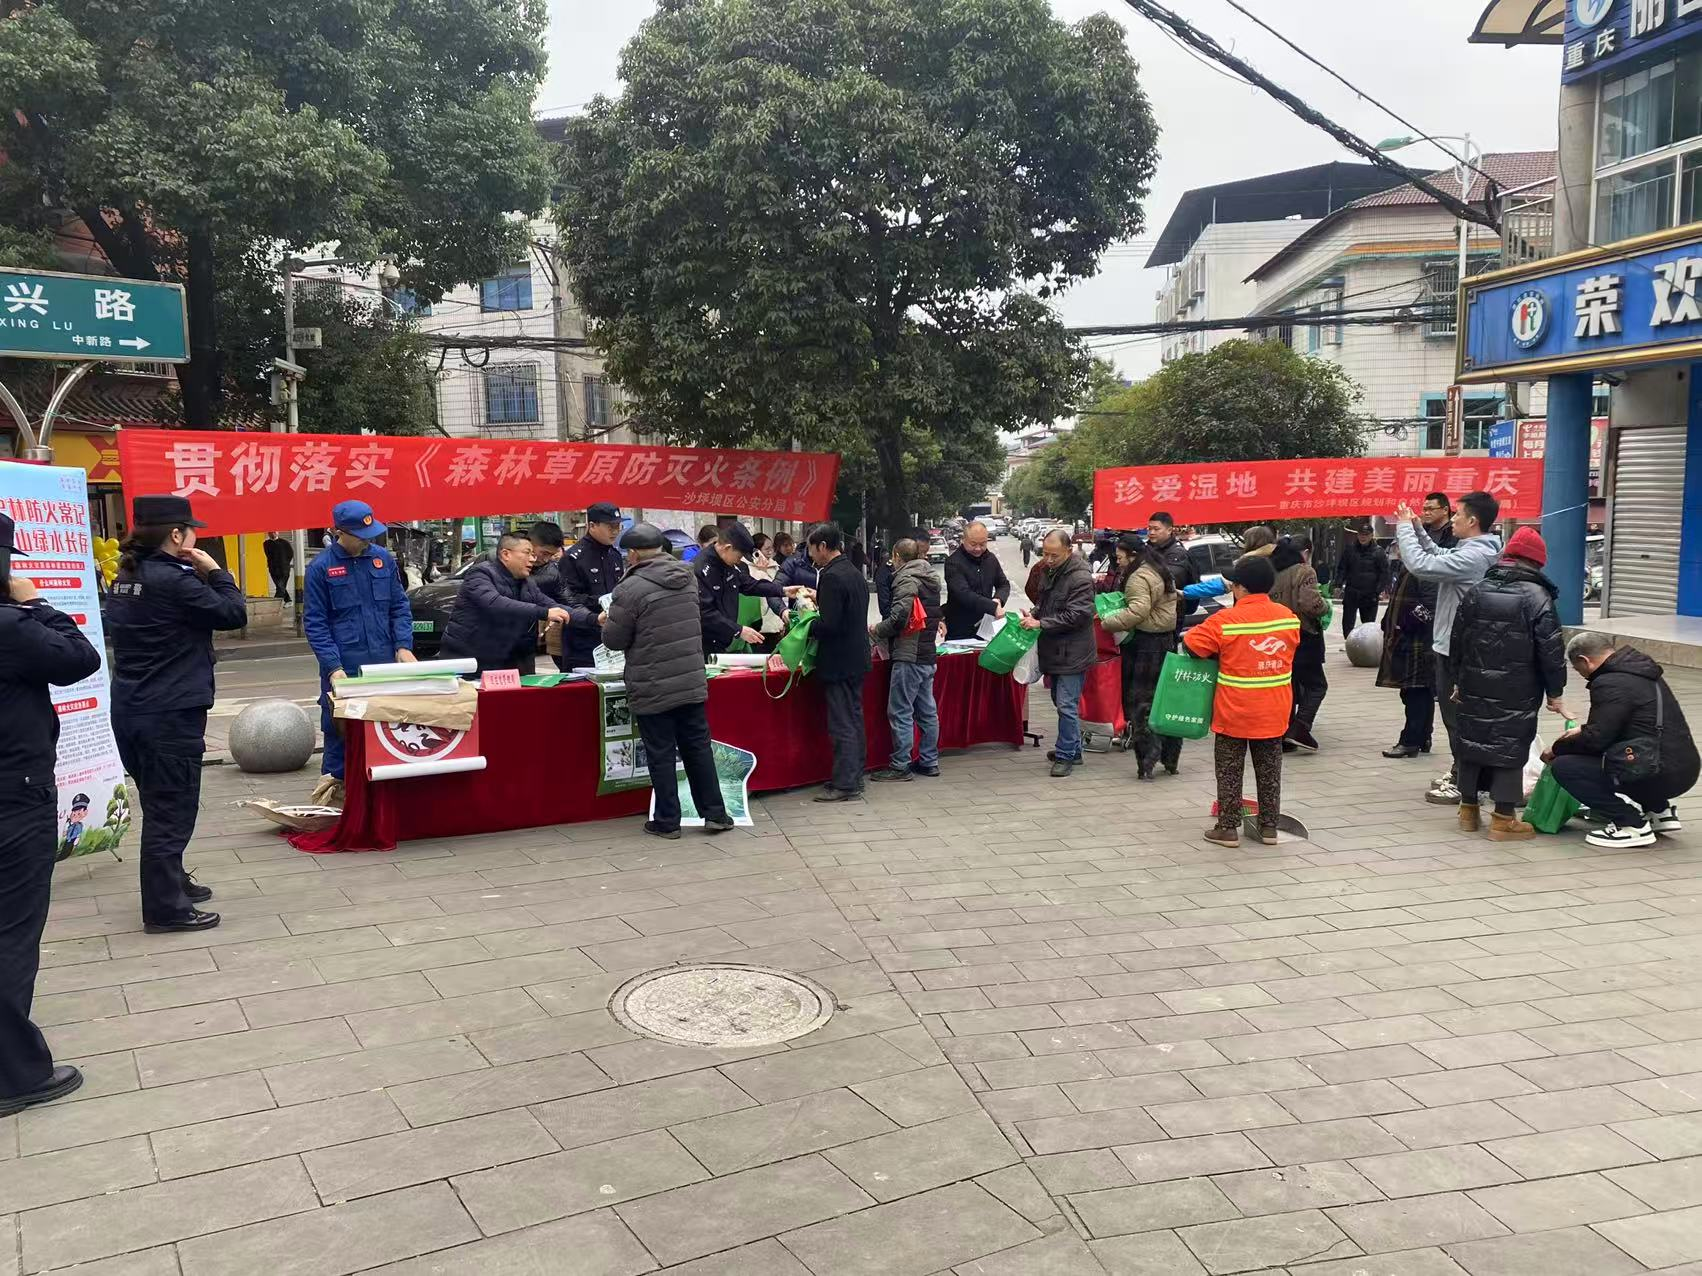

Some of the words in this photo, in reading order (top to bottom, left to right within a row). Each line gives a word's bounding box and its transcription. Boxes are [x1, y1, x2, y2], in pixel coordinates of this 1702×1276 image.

[1565, 28, 1615, 70] 重庆
[1574, 256, 1702, 337] 荣欢
[0, 317, 39, 329] XING
[53, 321, 73, 331] LU
[72, 334, 112, 348] 中新路
[1113, 472, 1259, 505] 珍爱湿地
[1285, 466, 1522, 496] 共建美丽重庆
